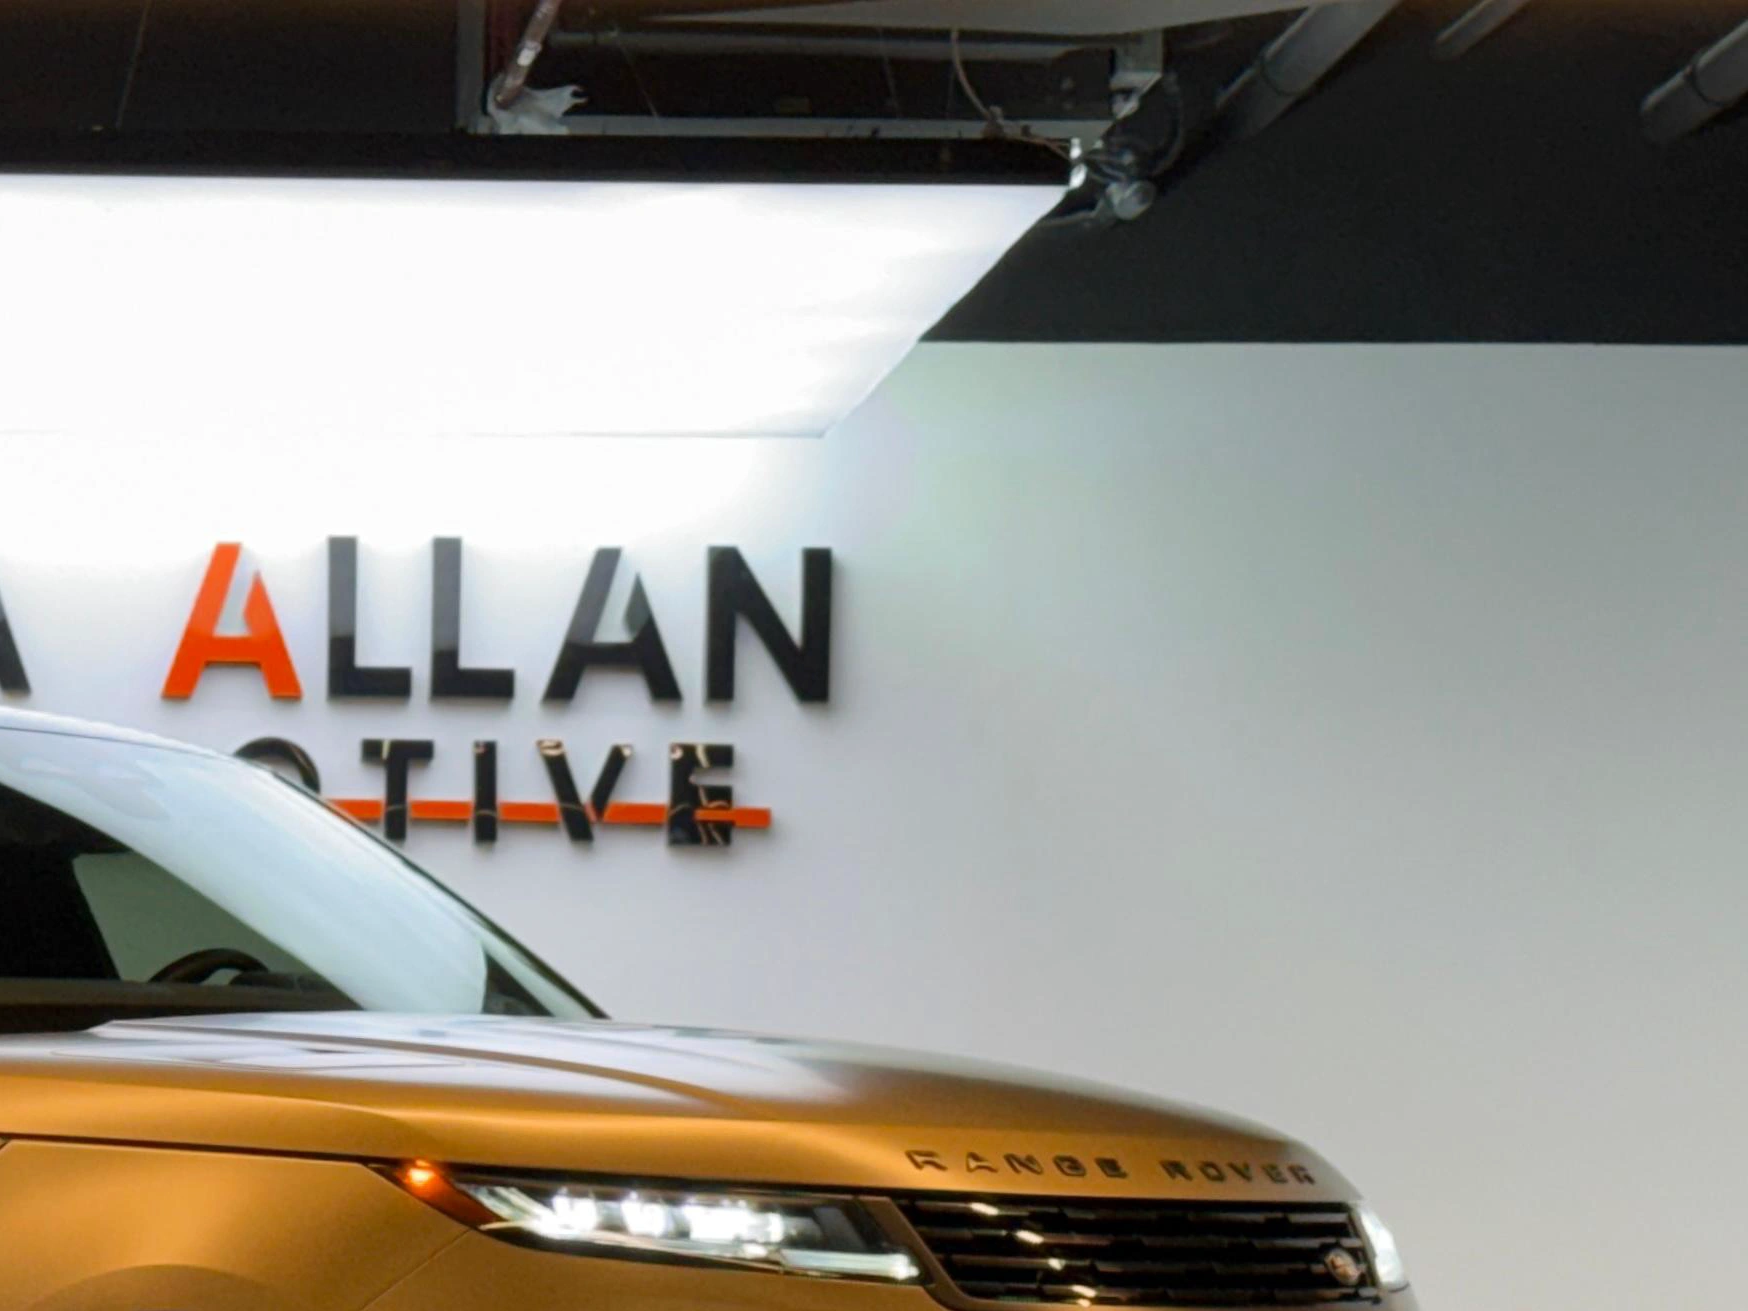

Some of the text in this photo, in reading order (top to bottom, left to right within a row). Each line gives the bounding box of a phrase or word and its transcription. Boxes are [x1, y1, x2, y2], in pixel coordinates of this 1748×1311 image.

[161, 535, 832, 704] ALLAN
[905, 1150, 1316, 1186] RANGE ROVER
